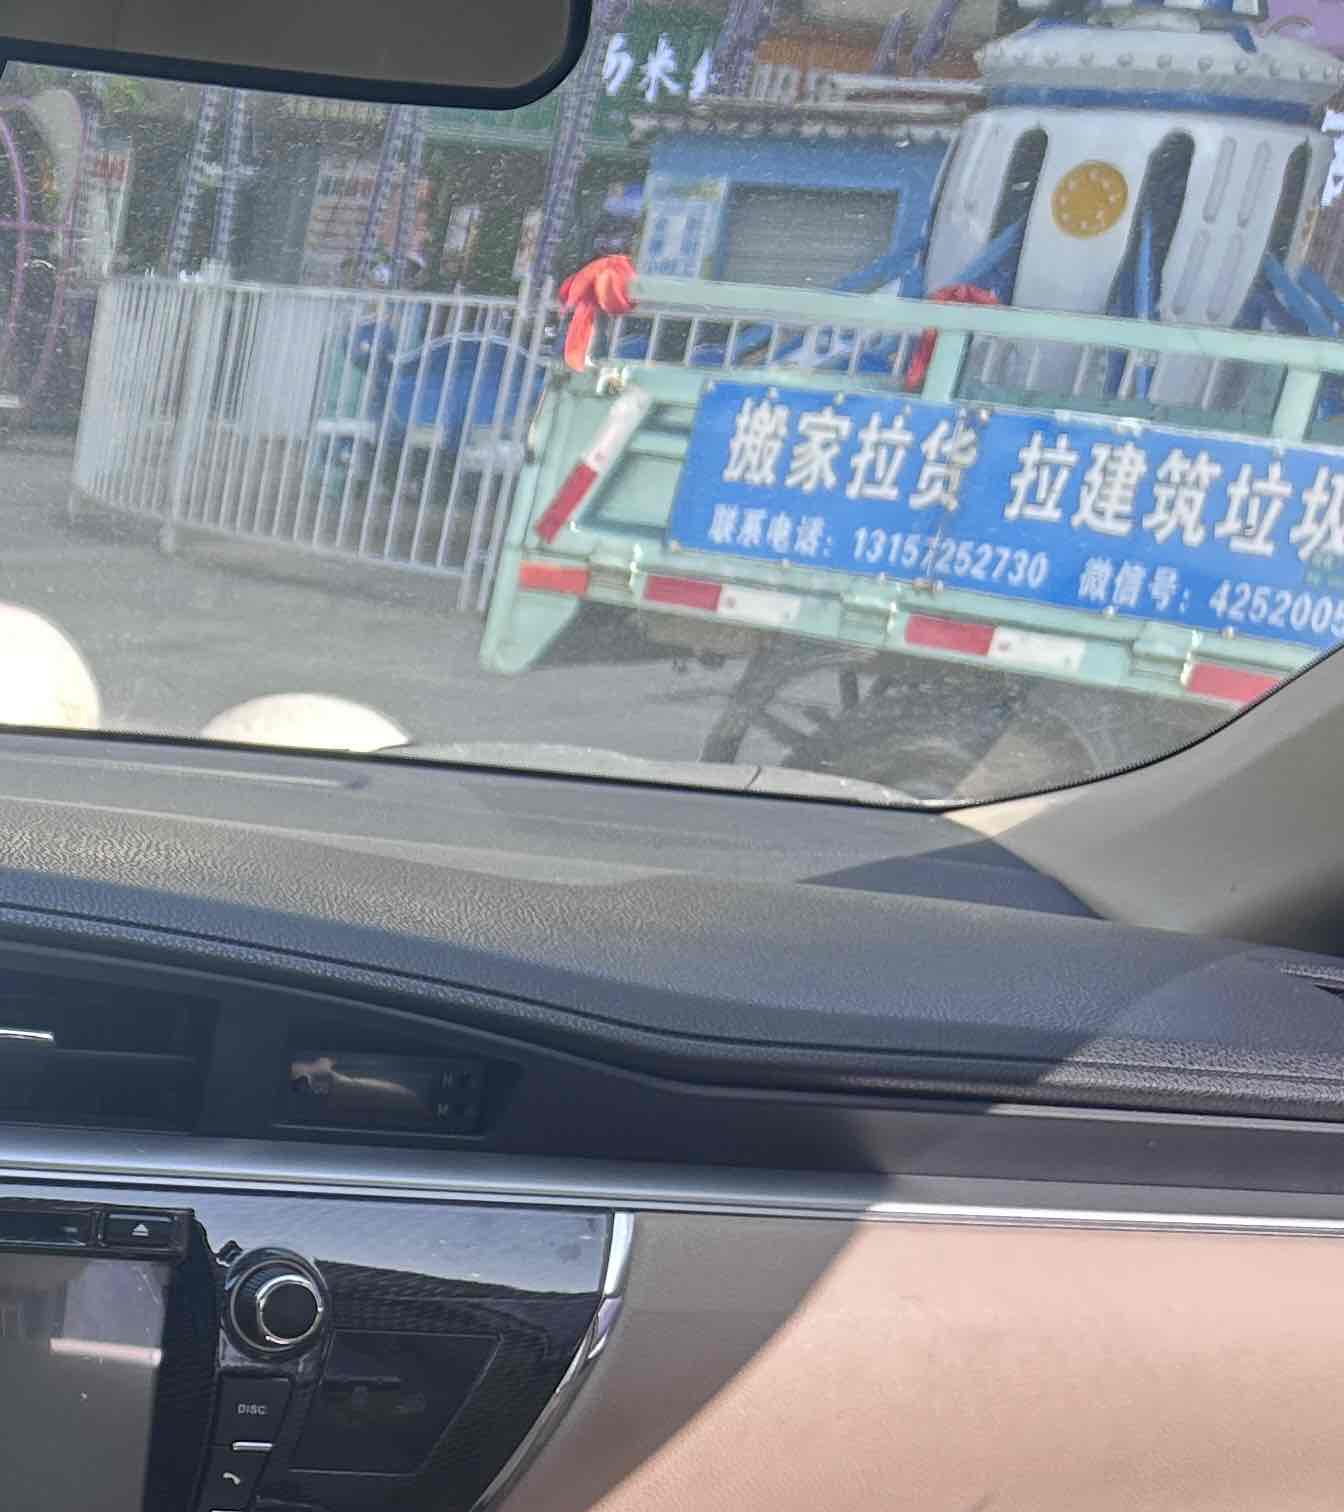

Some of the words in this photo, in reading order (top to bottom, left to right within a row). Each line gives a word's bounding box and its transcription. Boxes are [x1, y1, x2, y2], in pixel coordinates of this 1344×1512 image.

[723, 398, 977, 513] 搬家拉货
[236, 1403, 268, 1415] DISC
